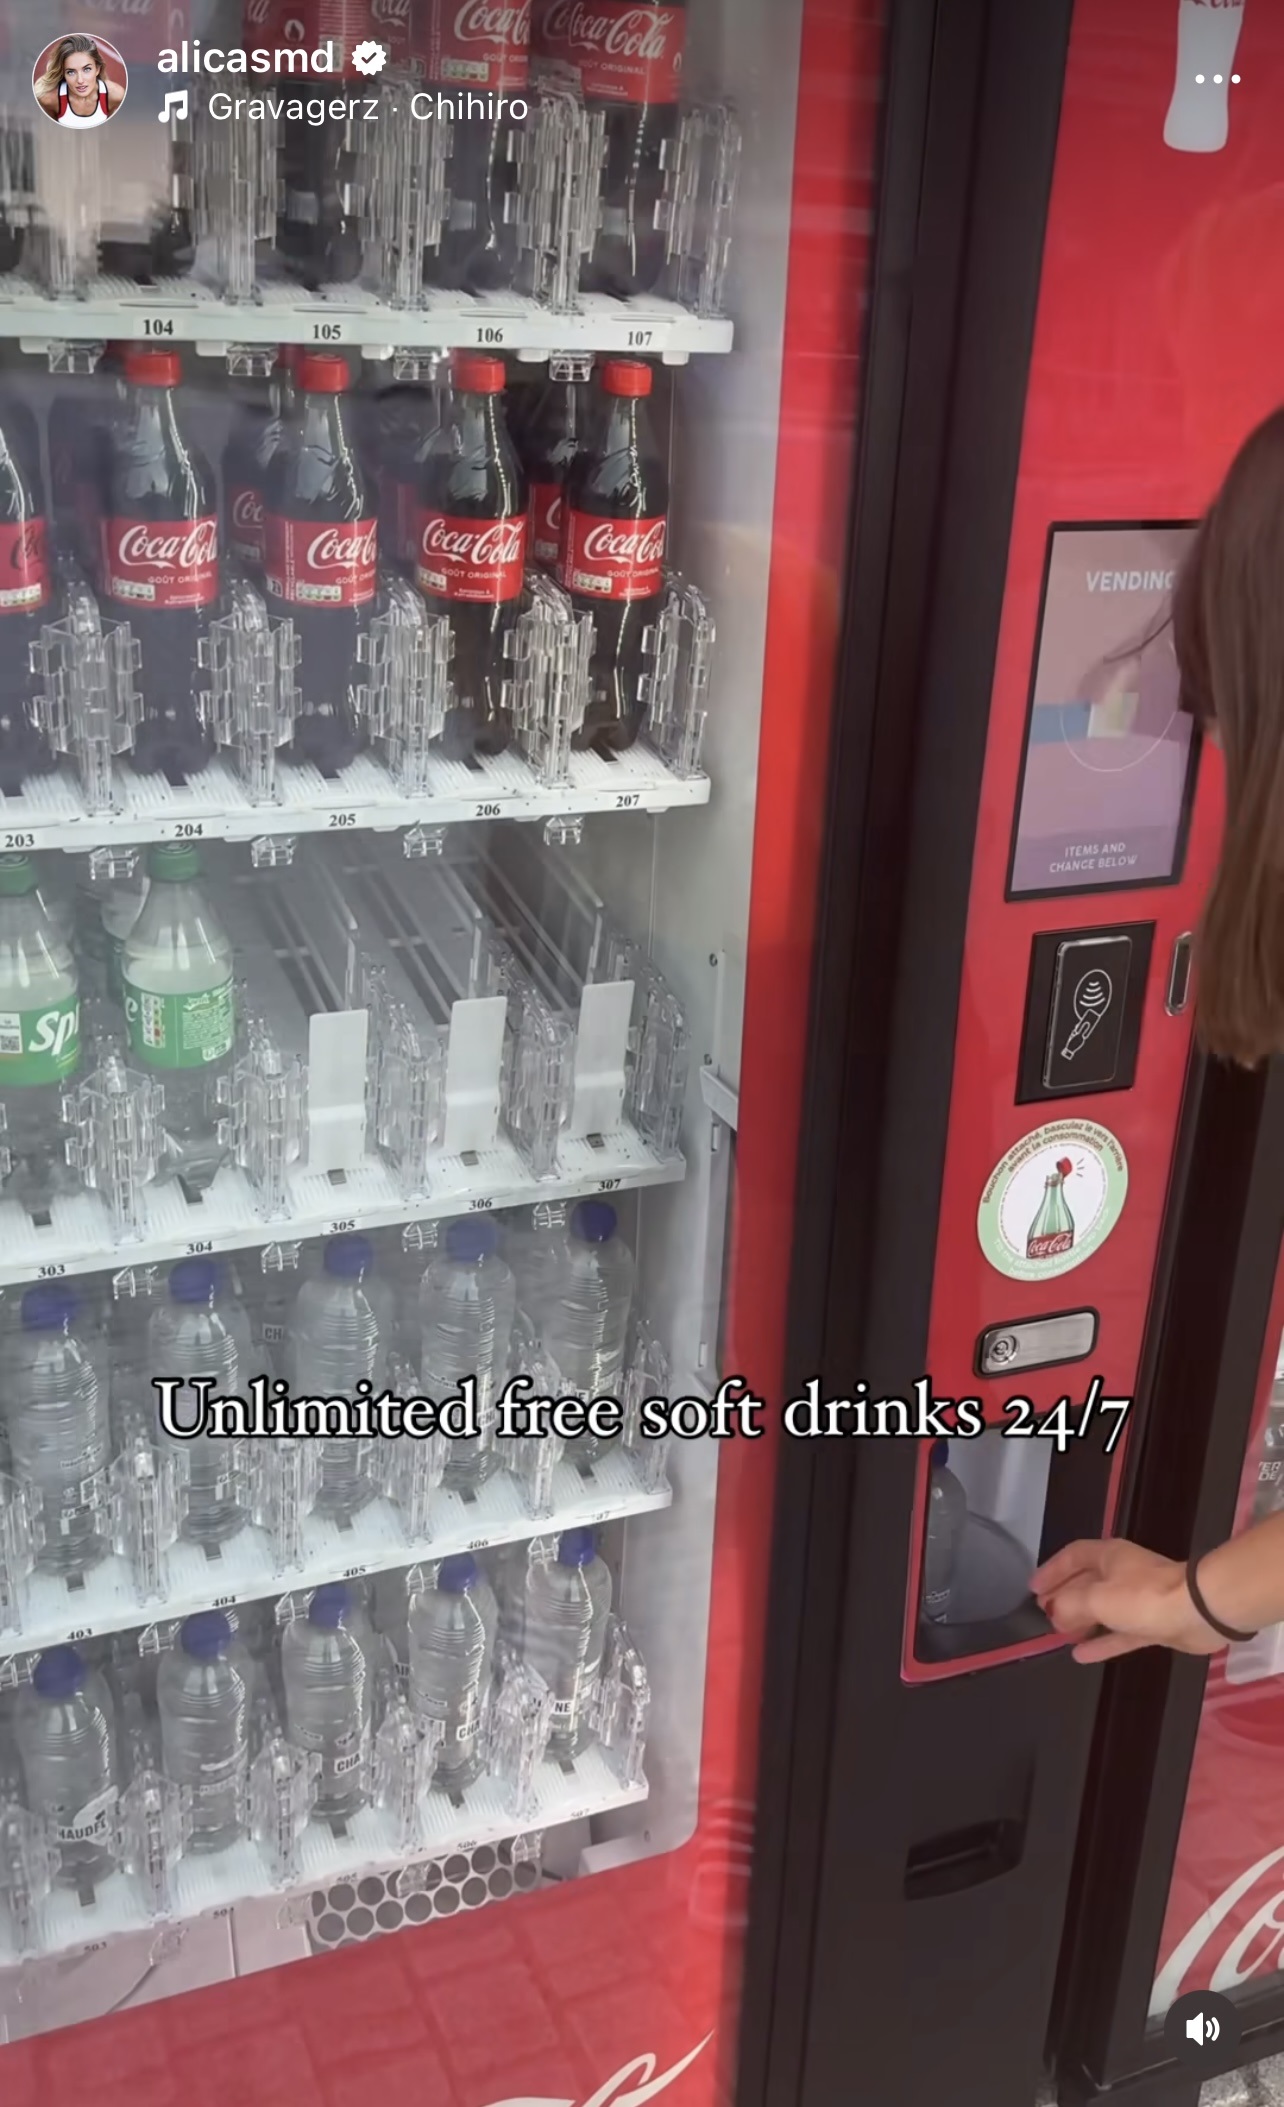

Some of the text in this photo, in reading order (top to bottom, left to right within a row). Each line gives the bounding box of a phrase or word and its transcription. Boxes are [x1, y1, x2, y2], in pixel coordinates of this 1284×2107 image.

[142, 318, 174, 337] 104
[311, 323, 342, 341] 105
[475, 327, 504, 344] 106
[626, 331, 652, 347] 107
[422, 518, 523, 565] Coca-Cola
[616, 795, 640, 807] 207
[475, 804, 501, 817] 206
[329, 813, 357, 827] 205
[174, 823, 203, 837] 204
[5, 834, 35, 848] 203
[1065, 842, 1126, 858] ITEMS AND
[1098, 854, 1138, 868] BELOW
[1042, 1131, 1104, 1152] consommation
[599, 1178, 621, 1191] 307
[469, 1198, 493, 1211] 306
[330, 1220, 356, 1232] 305
[186, 1241, 214, 1254] 304
[38, 1264, 66, 1278] 303
[343, 1565, 367, 1577] 405
[212, 1595, 236, 1608] 404
[67, 1627, 93, 1641] 403
